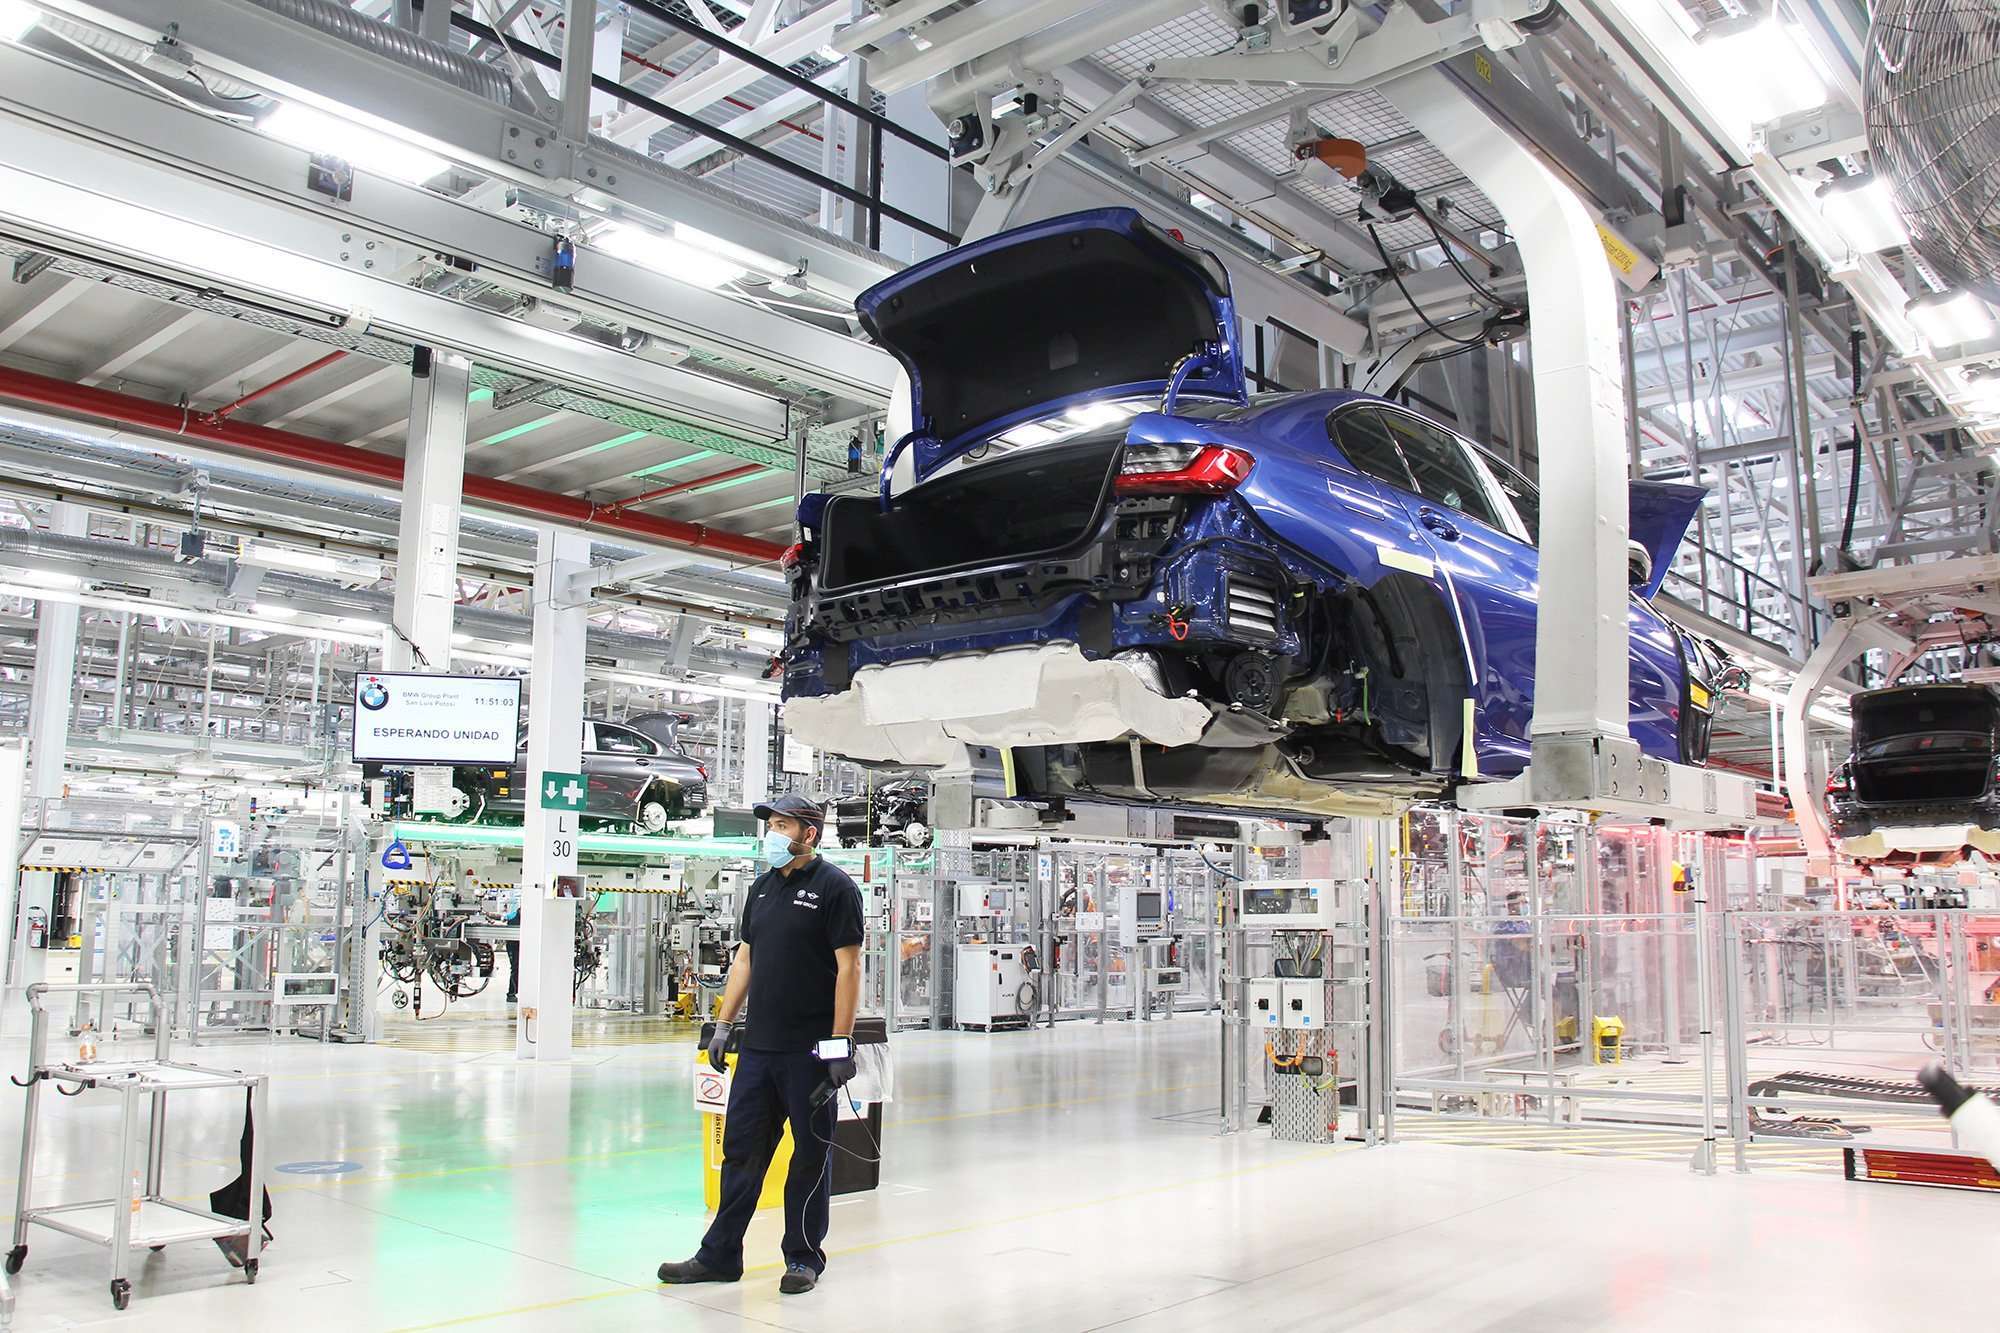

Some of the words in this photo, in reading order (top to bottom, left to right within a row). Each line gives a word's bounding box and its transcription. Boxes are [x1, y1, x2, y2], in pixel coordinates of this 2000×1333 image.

[475, 697, 514, 706] 11:51:03
[373, 727, 450, 739] ESPERANDO
[453, 730, 499, 740] UNIDAD
[559, 815, 567, 833] L
[552, 840, 571, 857] 30
